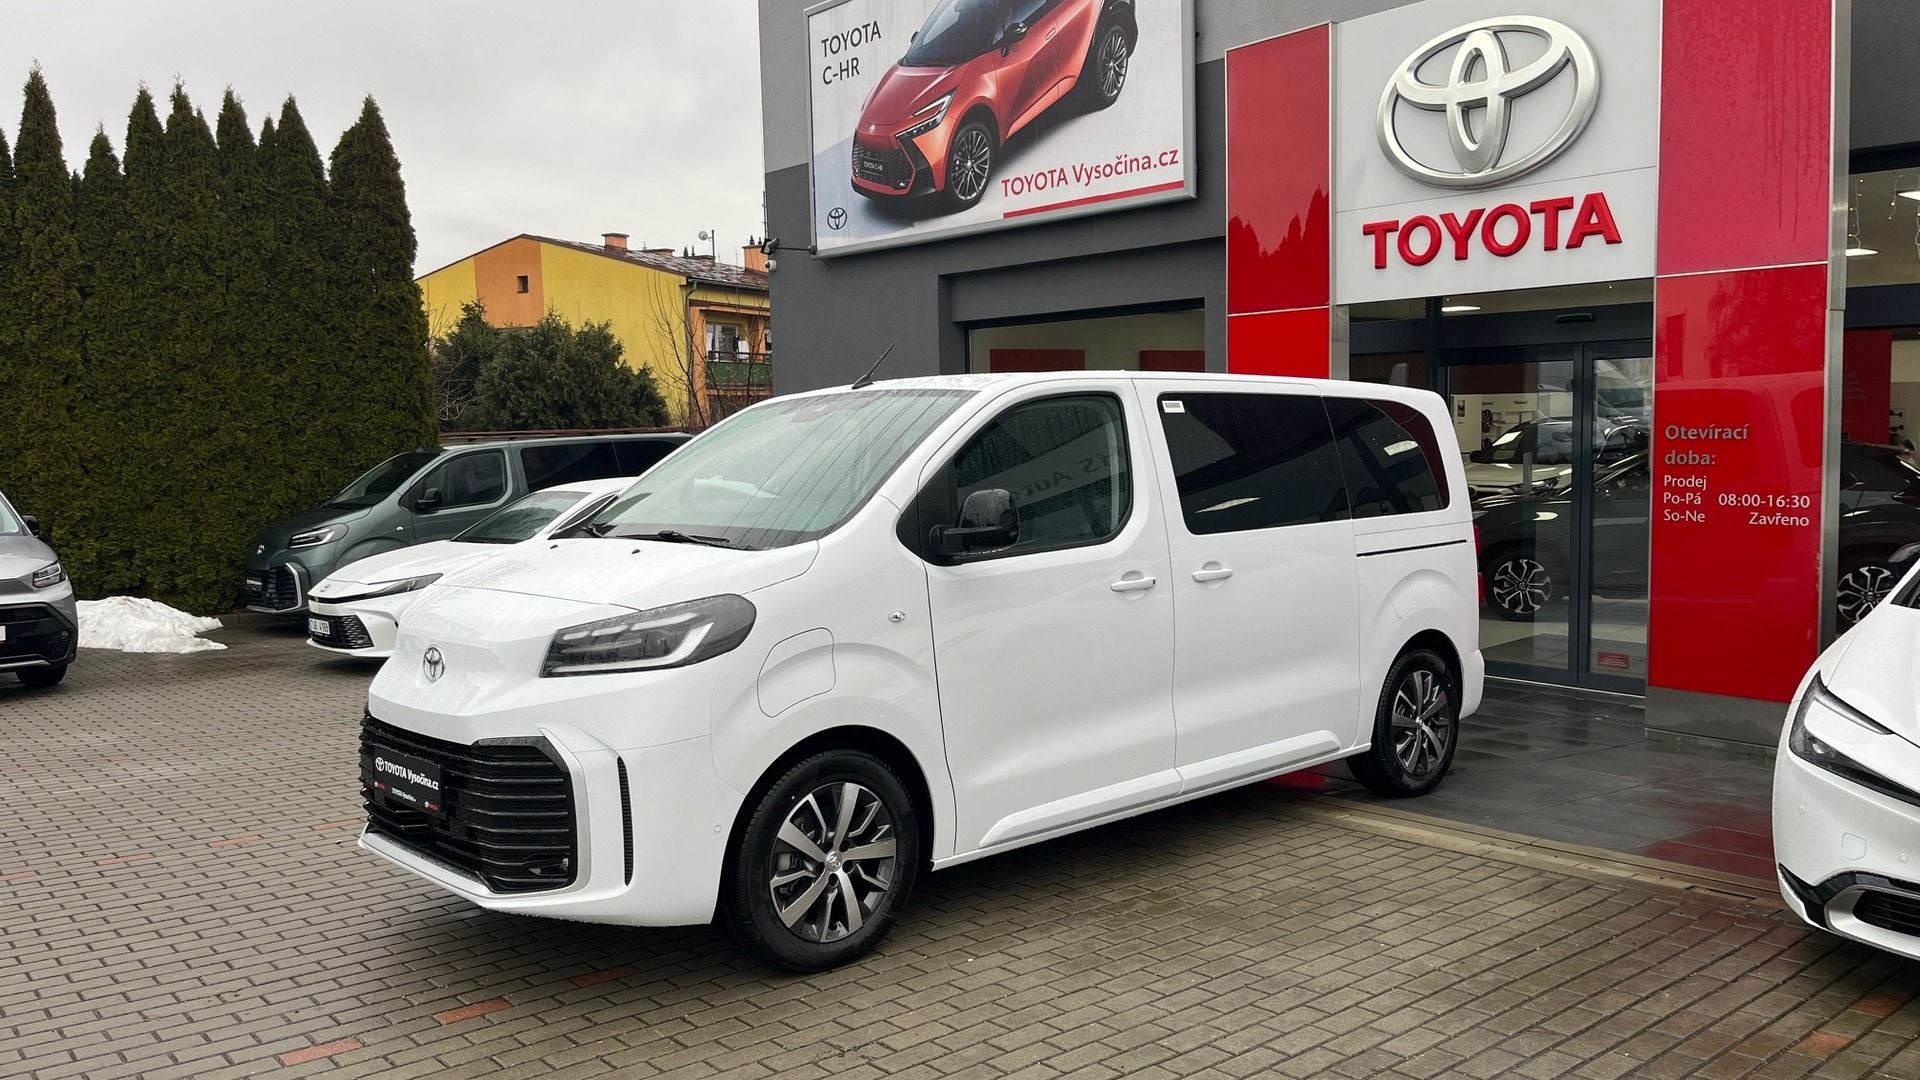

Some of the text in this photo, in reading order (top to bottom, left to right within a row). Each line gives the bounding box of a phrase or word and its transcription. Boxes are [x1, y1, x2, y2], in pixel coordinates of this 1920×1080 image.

[821, 20, 882, 58] TOYOTA
[822, 57, 860, 85] C-HR
[1001, 149, 1179, 198] TOYOTA Vysočina.cz
[1363, 192, 1622, 269] TOYOTA
[1664, 423, 1750, 440] Otevírací
[1664, 450, 1716, 465] doba:
[1663, 475, 1707, 491] Prodej
[1663, 492, 1811, 509] Po-Pá 08:00-16:30
[1663, 509, 1810, 527] So-Ne Zavřeno
[384, 760, 439, 791] TOYOTA Vysočina.cz
